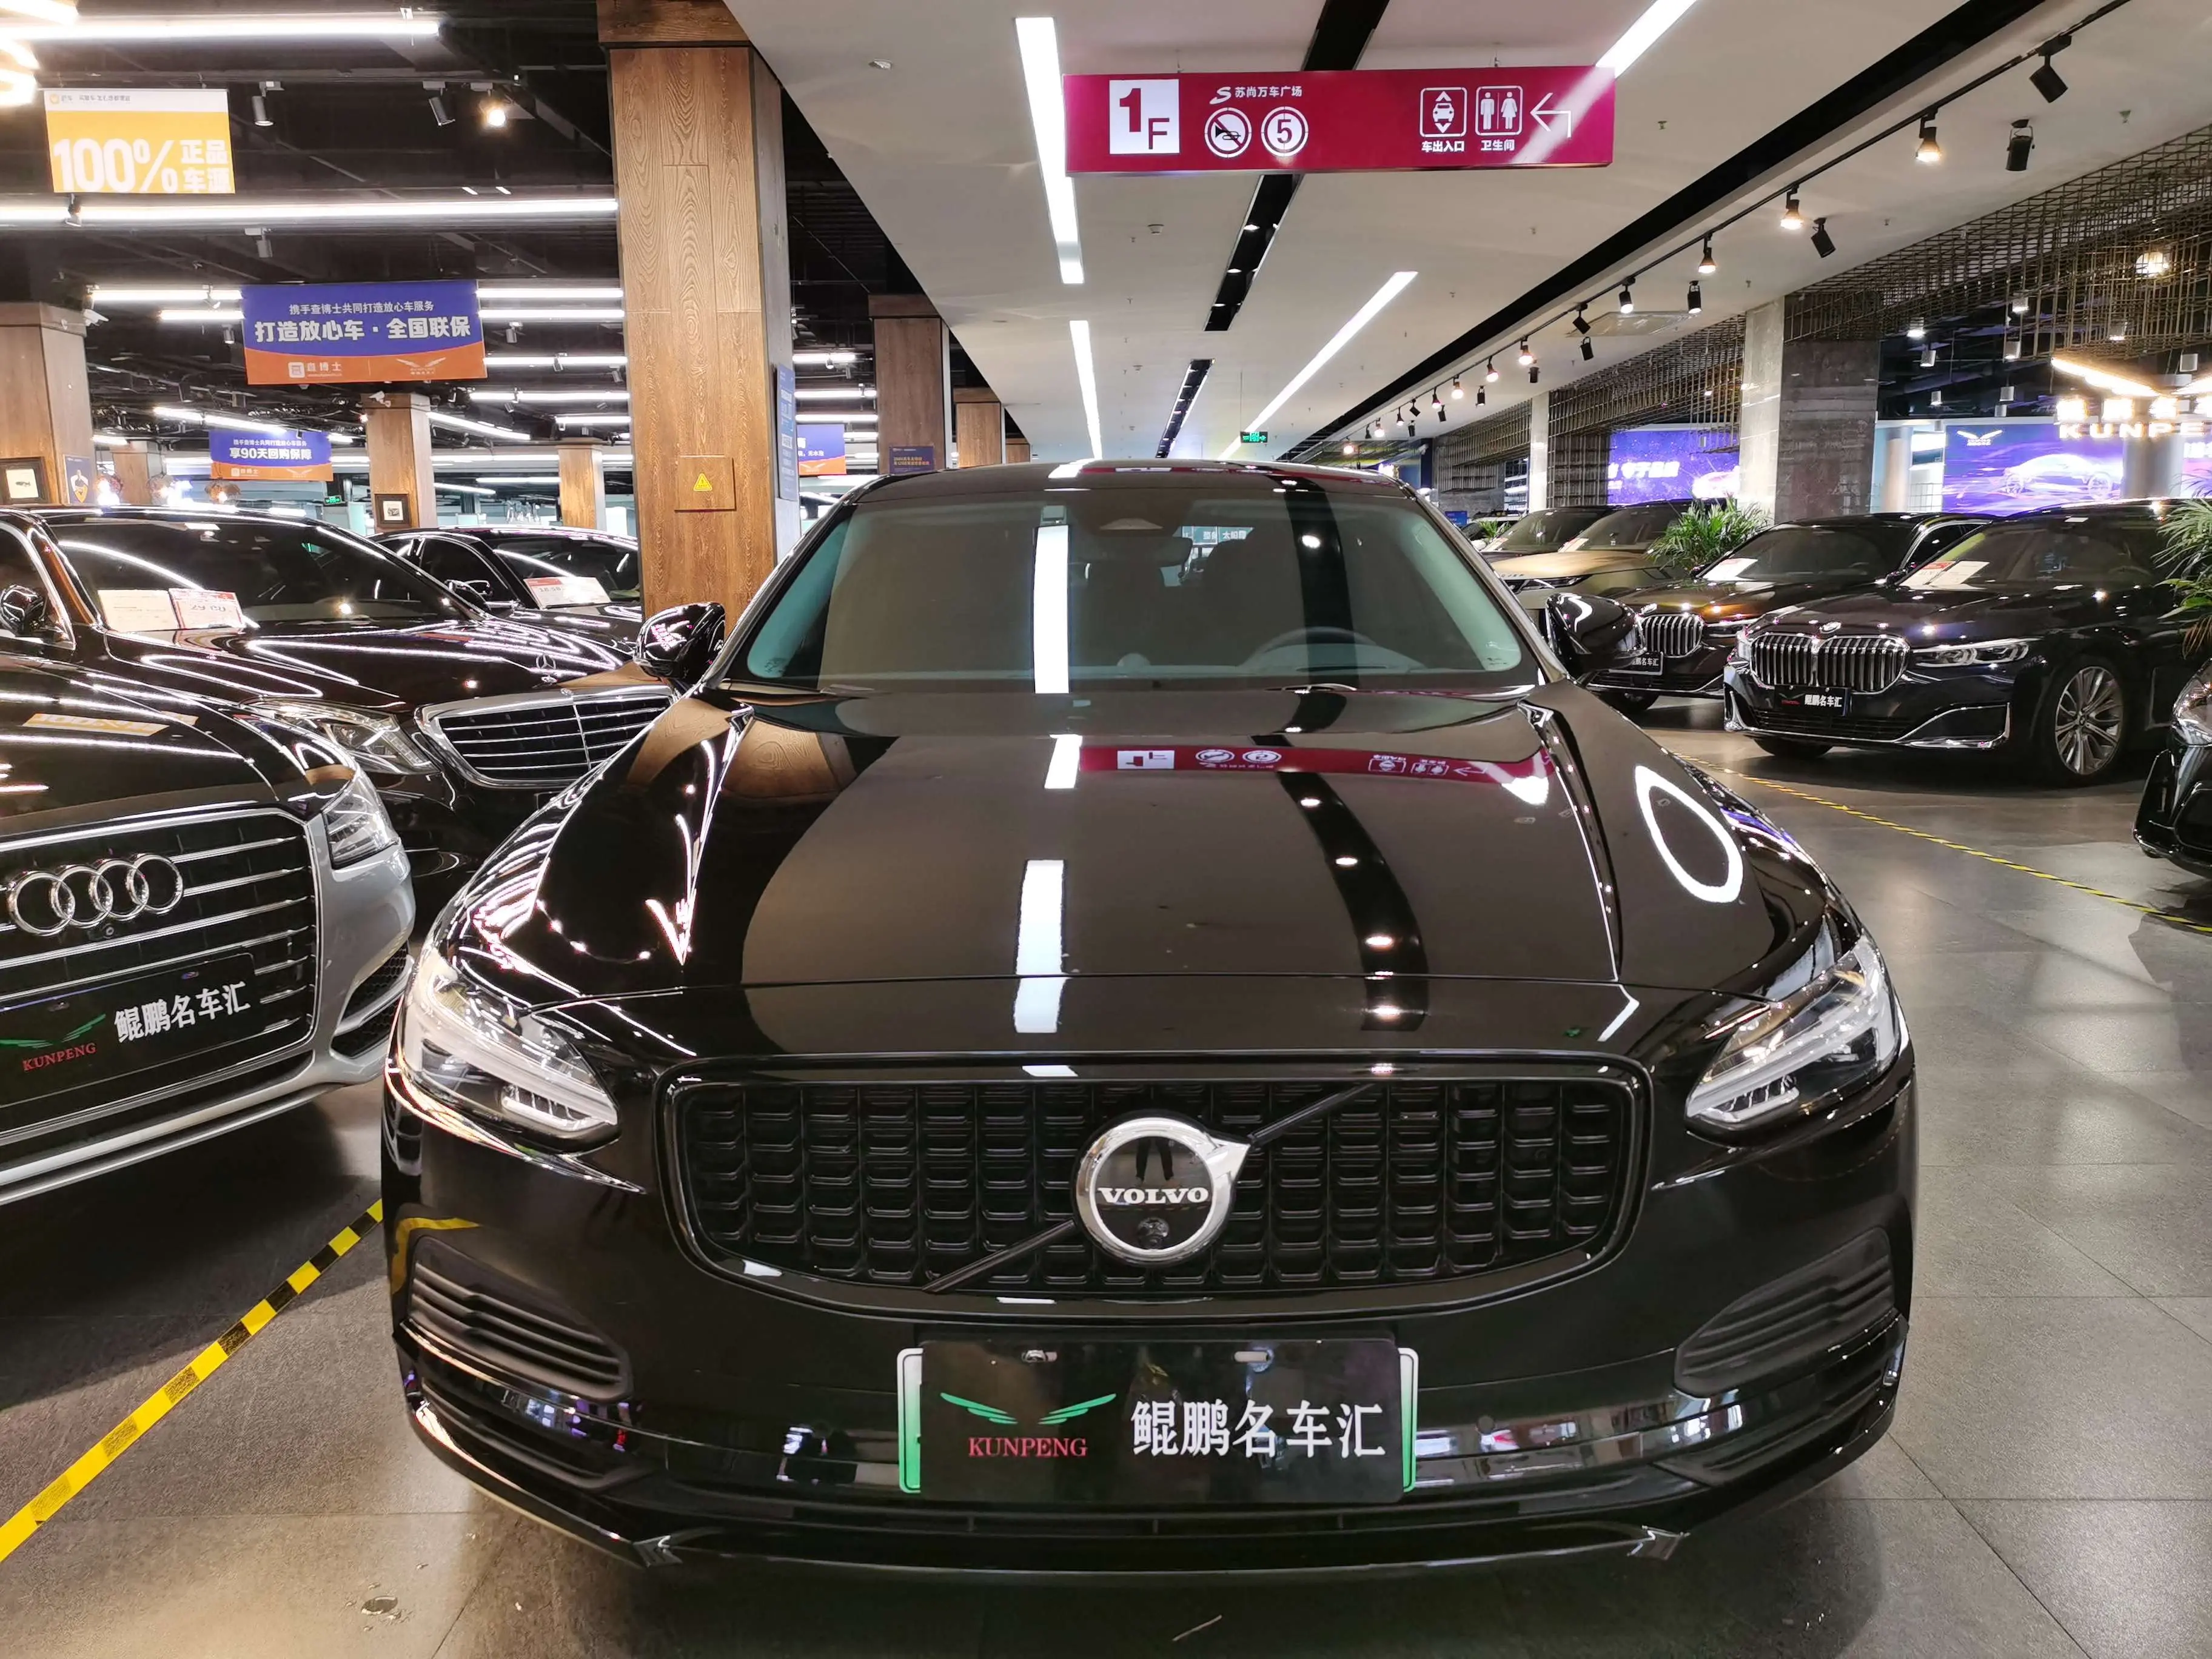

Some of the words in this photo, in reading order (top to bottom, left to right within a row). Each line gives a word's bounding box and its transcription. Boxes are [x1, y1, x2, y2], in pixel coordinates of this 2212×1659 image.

[1235, 85, 1302, 98] 苏尚万车广场
[1276, 119, 1292, 144] 5
[179, 139, 229, 164] 正品
[1421, 140, 1465, 152] 车出入口
[1480, 139, 1515, 152] 卫生间
[53, 138, 175, 193] 100%
[183, 167, 231, 193] 车源
[289, 300, 434, 316] 携手查博士共同打造放心车服务
[229, 447, 312, 460] 享90天回购保障
[113, 981, 251, 1044] 鲲鹏名车汇
[22, 1042, 97, 1072] KUNPENG
[1098, 1187, 1209, 1204] VOLVO
[1130, 1398, 1386, 1458] 鲲鹏名车汇
[968, 1437, 1088, 1456] KUNPENG
